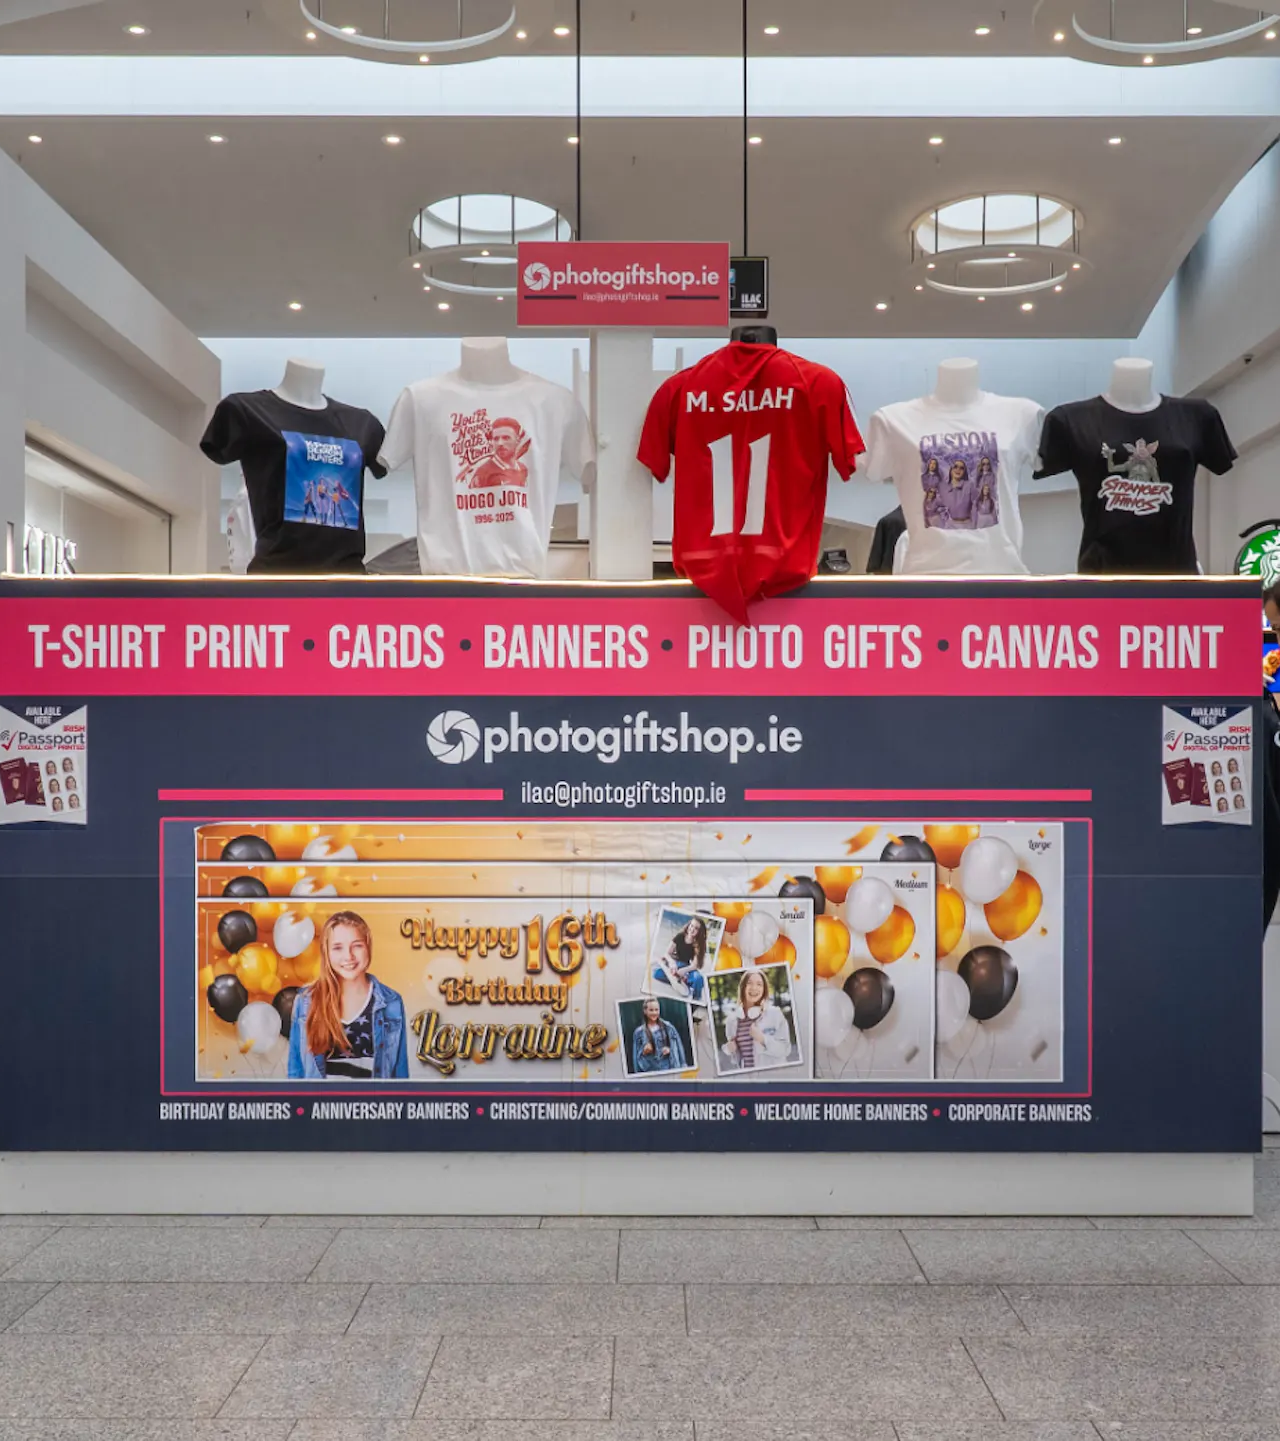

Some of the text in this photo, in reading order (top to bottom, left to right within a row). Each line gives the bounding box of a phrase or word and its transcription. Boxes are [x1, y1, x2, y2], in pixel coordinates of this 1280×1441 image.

[553, 263, 719, 291] photogiftshop.ie
[741, 294, 761, 303] ILAC
[686, 387, 794, 412] M. SALAH
[451, 434, 485, 455] Walk
[707, 433, 771, 537] 11
[1100, 477, 1171, 503] STRANGER
[456, 490, 529, 510] DIOGO JOTA
[1108, 492, 1160, 512] THINGS
[28, 624, 1224, 669] T-SHIRT PRINT CARDS BANNERS PHOTO GIFTS CANVAS PRINT
[25, 706, 61, 716] AVAILABLE
[34, 716, 52, 725] HERE
[1191, 707, 1227, 717] AVAILABLE
[1199, 717, 1218, 726] HERE
[18, 732, 85, 748] Passport
[483, 711, 803, 764] photogiftshop.ie
[1184, 732, 1251, 749] Passport
[521, 780, 726, 808] ilac@photogiftshop.ie
[1028, 840, 1052, 850] Large
[894, 879, 928, 889] Medium
[779, 910, 806, 920] Small
[401, 911, 621, 975] Happy 16th
[439, 976, 569, 1013] Birthday
[410, 1008, 608, 1076] Lorraine
[159, 1103, 1092, 1120] BIRTHDAY BANNERS ANNIVERSARY BANNERS CHRISTENING/COMMUNION BANNERS WELCOME HOME BANNERS CORPORATE BANNERS
